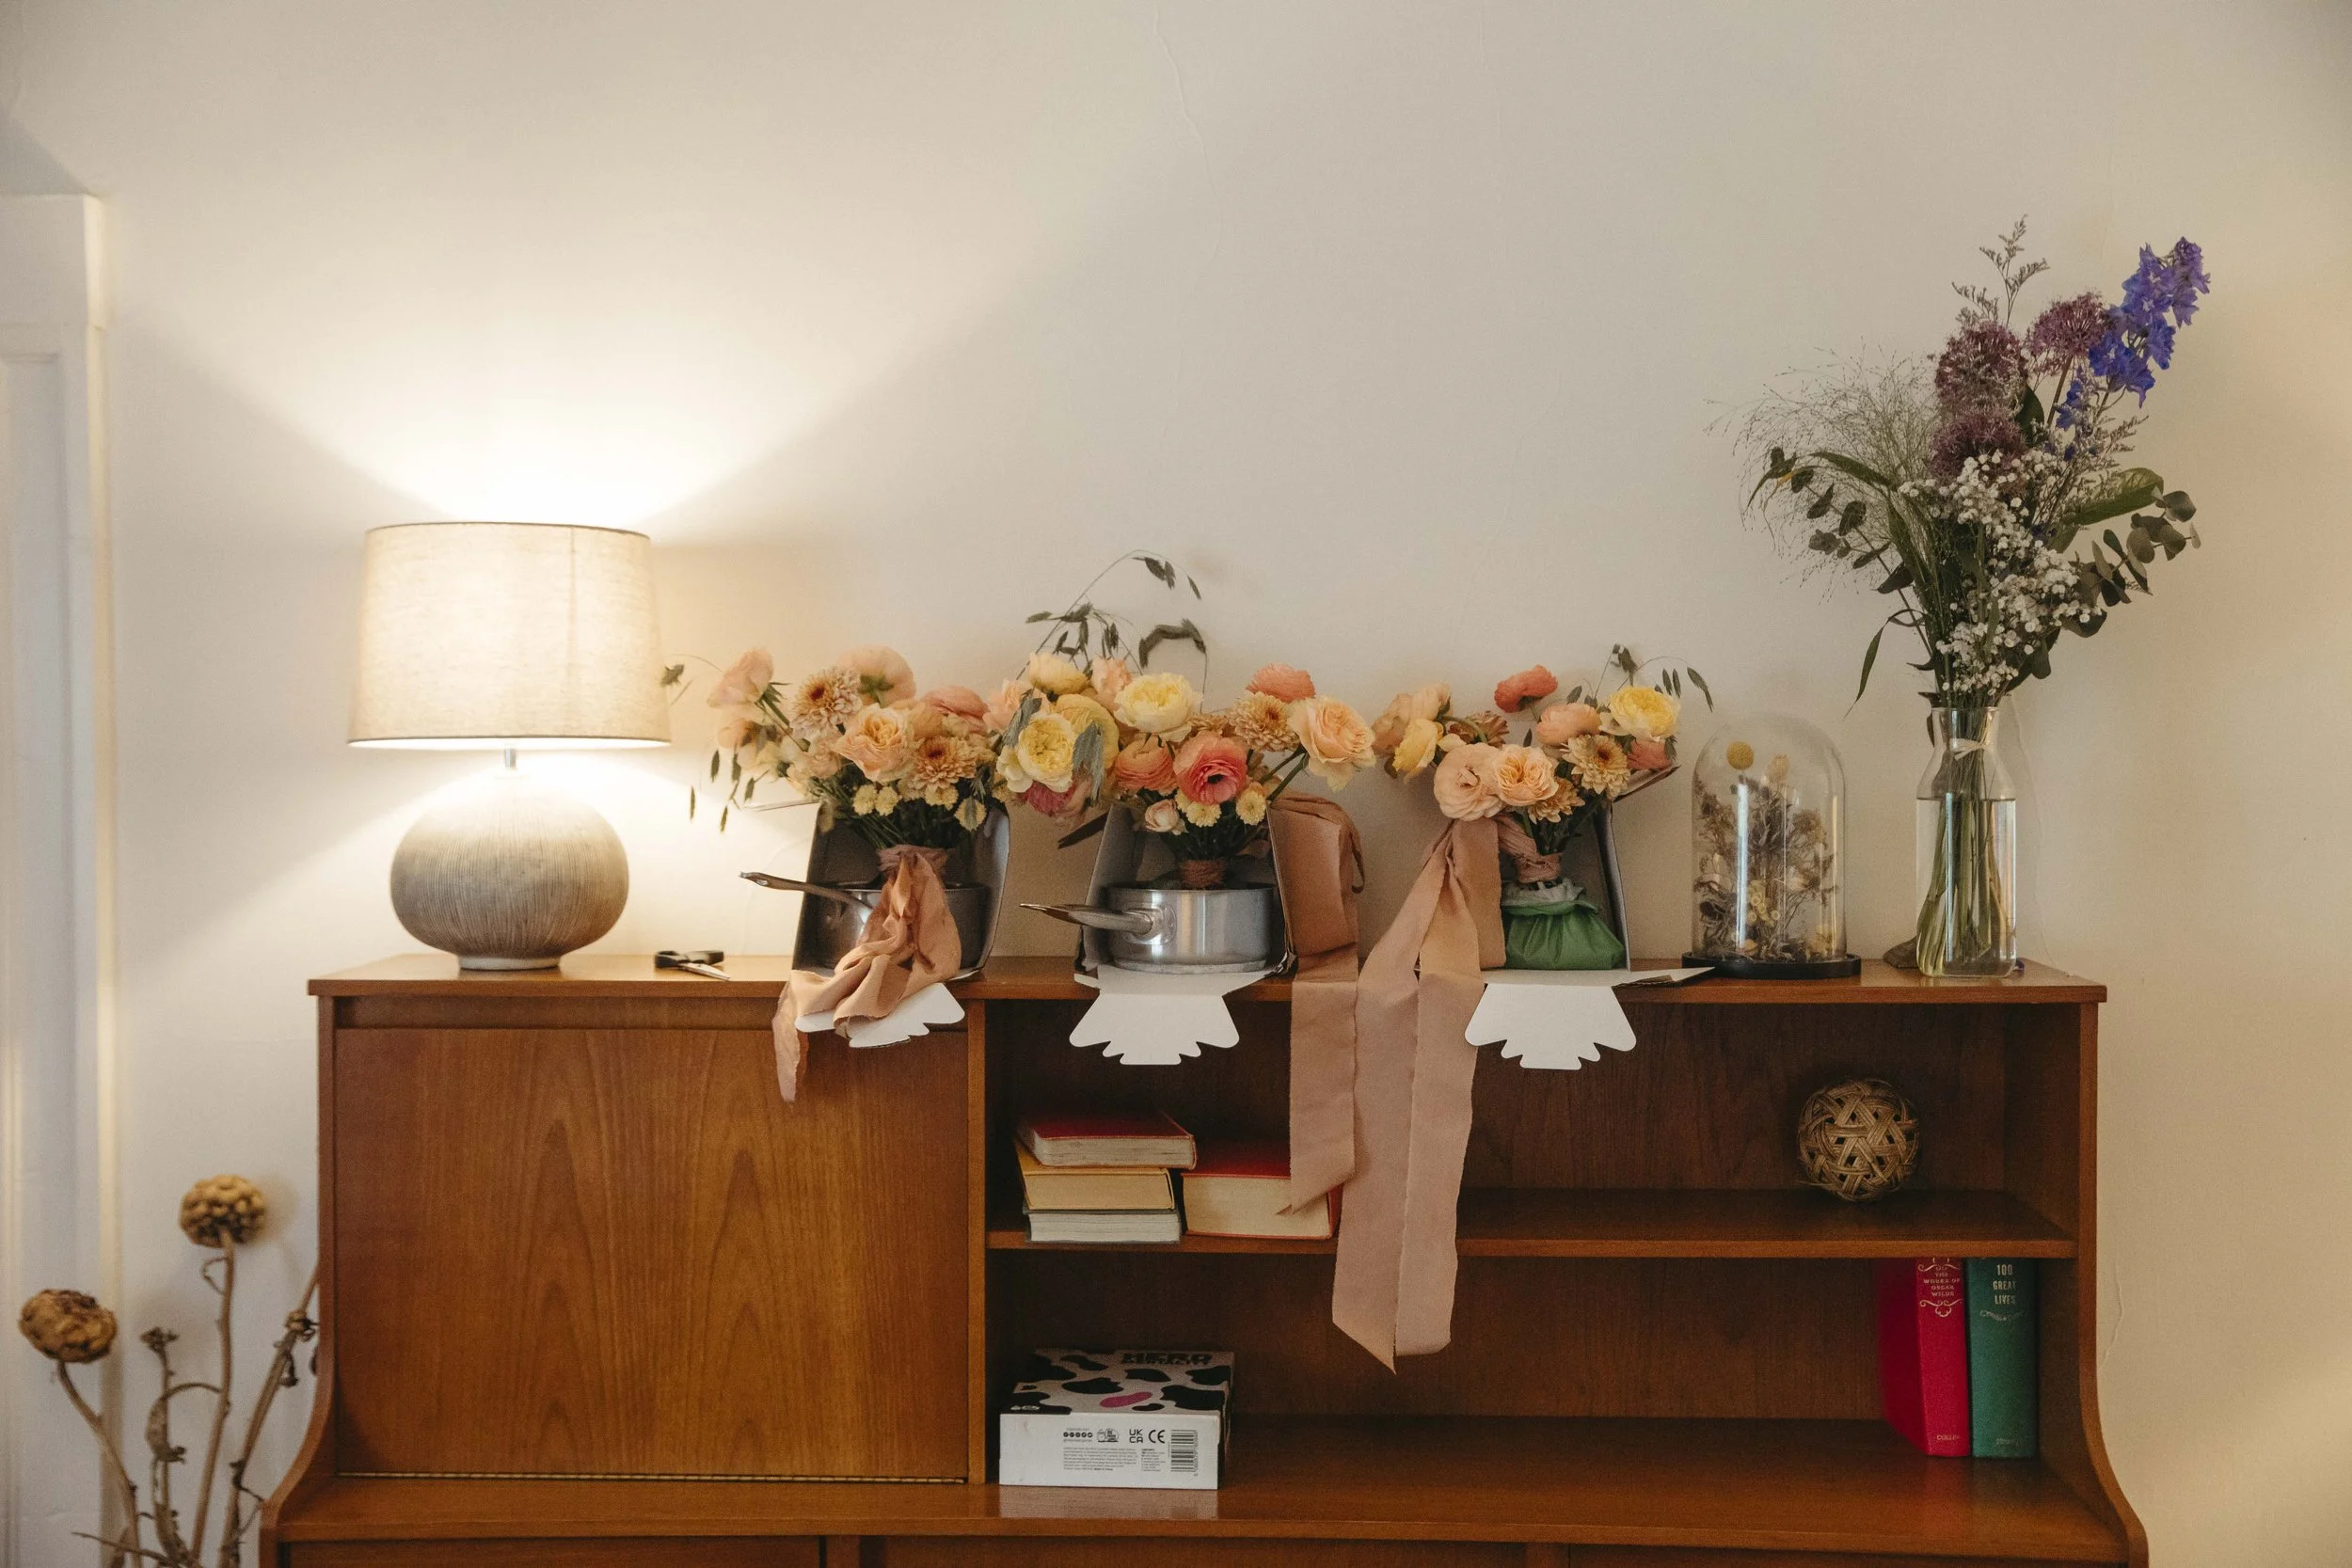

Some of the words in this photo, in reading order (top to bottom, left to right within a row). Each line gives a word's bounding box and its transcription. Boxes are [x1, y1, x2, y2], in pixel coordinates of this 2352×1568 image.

[1996, 1264, 2013, 1275] 100
[1993, 1281, 2016, 1291] GREAT
[1994, 1295, 2016, 1305] LIVES
